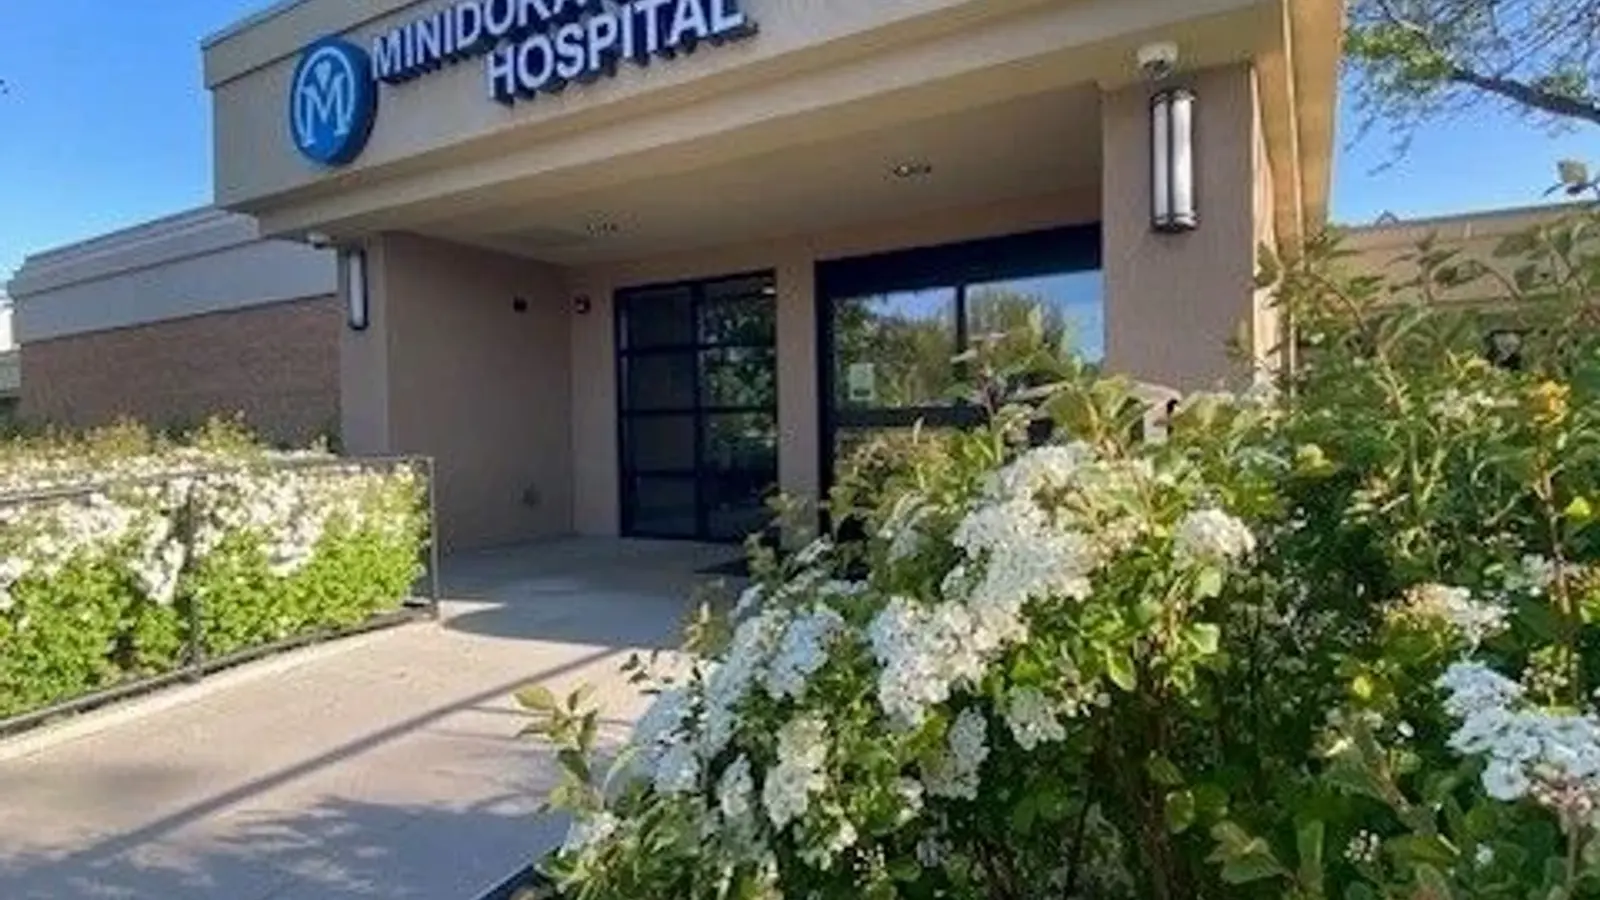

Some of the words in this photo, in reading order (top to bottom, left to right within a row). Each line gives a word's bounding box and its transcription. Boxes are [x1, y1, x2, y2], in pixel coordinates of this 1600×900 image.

[372, 0, 584, 80] MINIDOK
[490, 0, 744, 98] HOSPITAL
[300, 72, 350, 147] M
